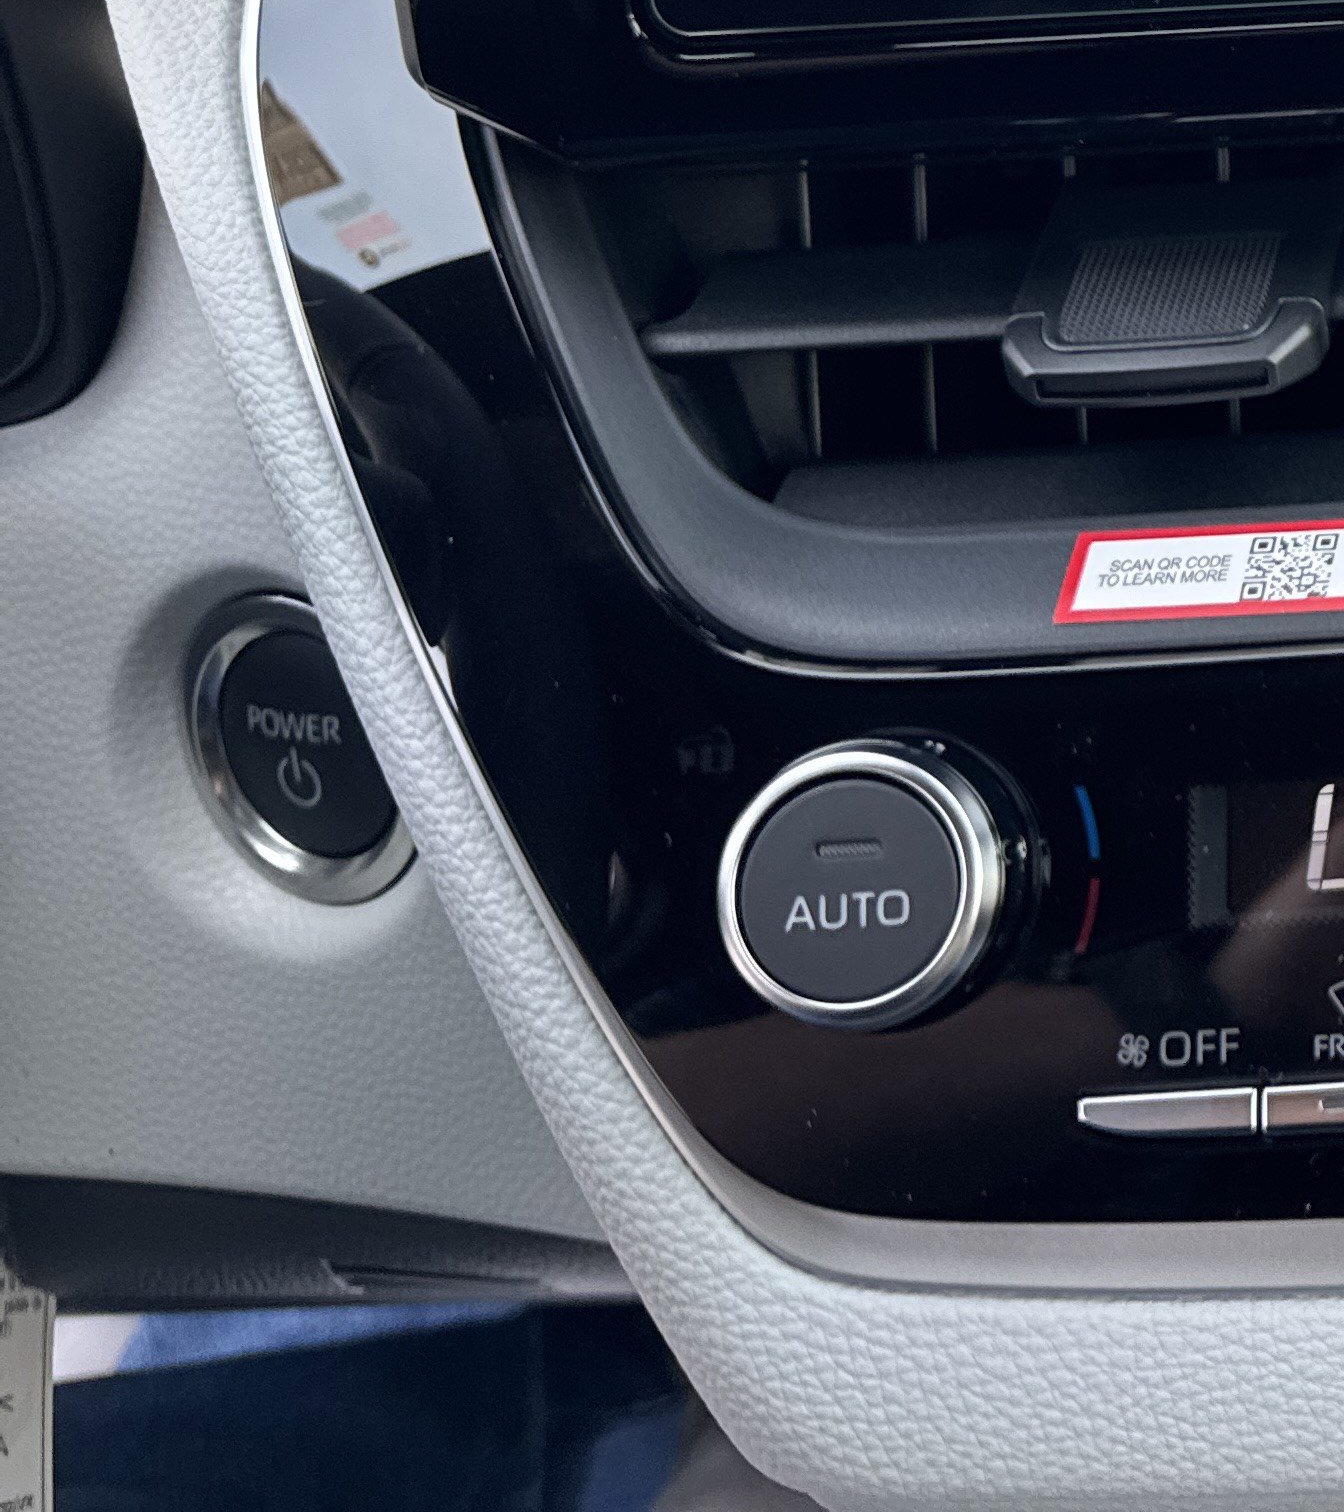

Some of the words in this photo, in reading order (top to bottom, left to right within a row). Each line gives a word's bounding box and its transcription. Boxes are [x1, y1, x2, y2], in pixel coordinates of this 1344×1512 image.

[1098, 573, 1121, 588] TO
[1122, 570, 1176, 586] LEARN
[1180, 567, 1228, 583] MORE
[1109, 558, 1154, 573] SCAN
[1157, 556, 1182, 571] QR
[1186, 554, 1232, 569] CODE
[246, 704, 342, 745] POWER
[784, 889, 911, 934] AUTO
[1158, 1027, 1241, 1067] OFF
